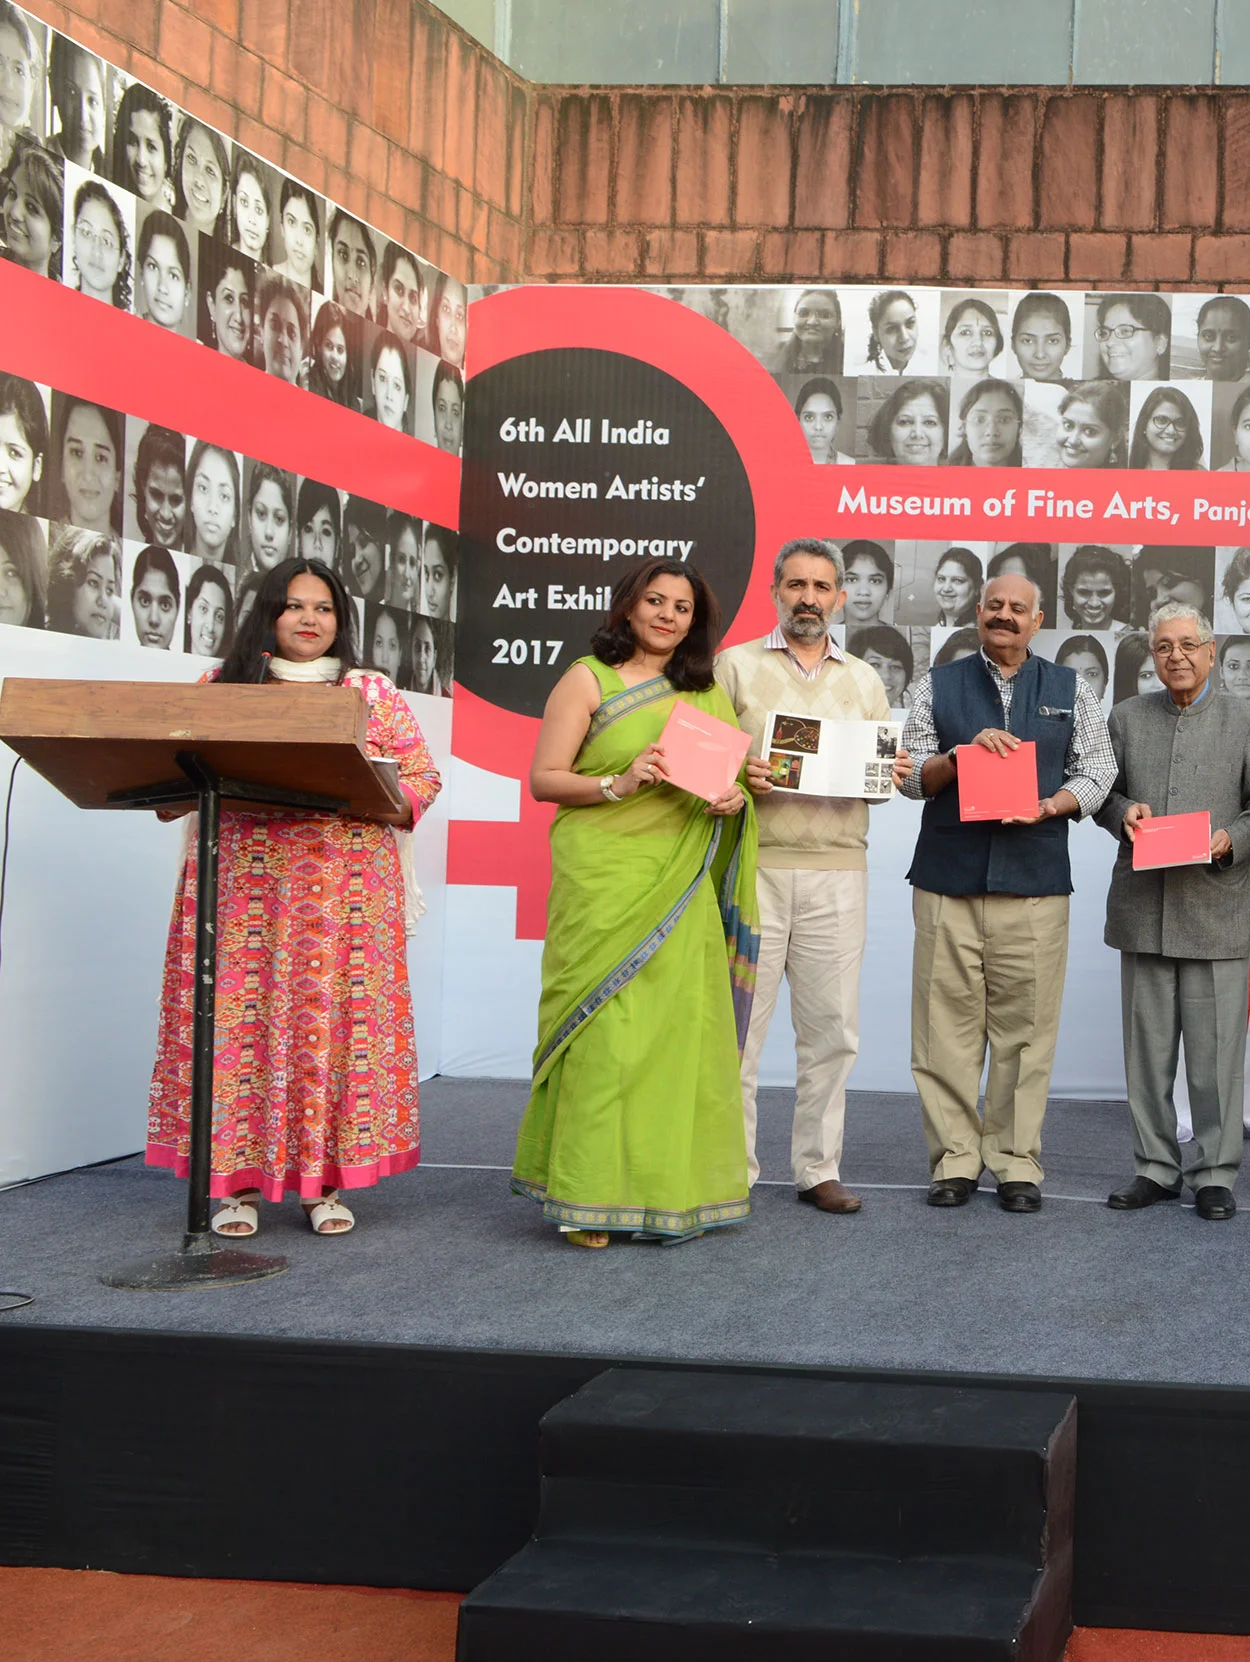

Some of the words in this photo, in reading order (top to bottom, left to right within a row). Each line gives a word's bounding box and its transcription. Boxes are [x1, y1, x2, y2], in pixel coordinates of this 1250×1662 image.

[499, 417, 545, 443] 6th
[552, 418, 591, 443] All
[601, 418, 670, 445] India
[497, 472, 598, 499] Women
[837, 485, 972, 516] Museum
[982, 489, 1017, 517] of
[1027, 489, 1094, 519] Fine
[1103, 491, 1180, 525] Arts,
[496, 527, 694, 563] Contemporary
[492, 583, 538, 609] Art
[491, 638, 564, 665] 2017
